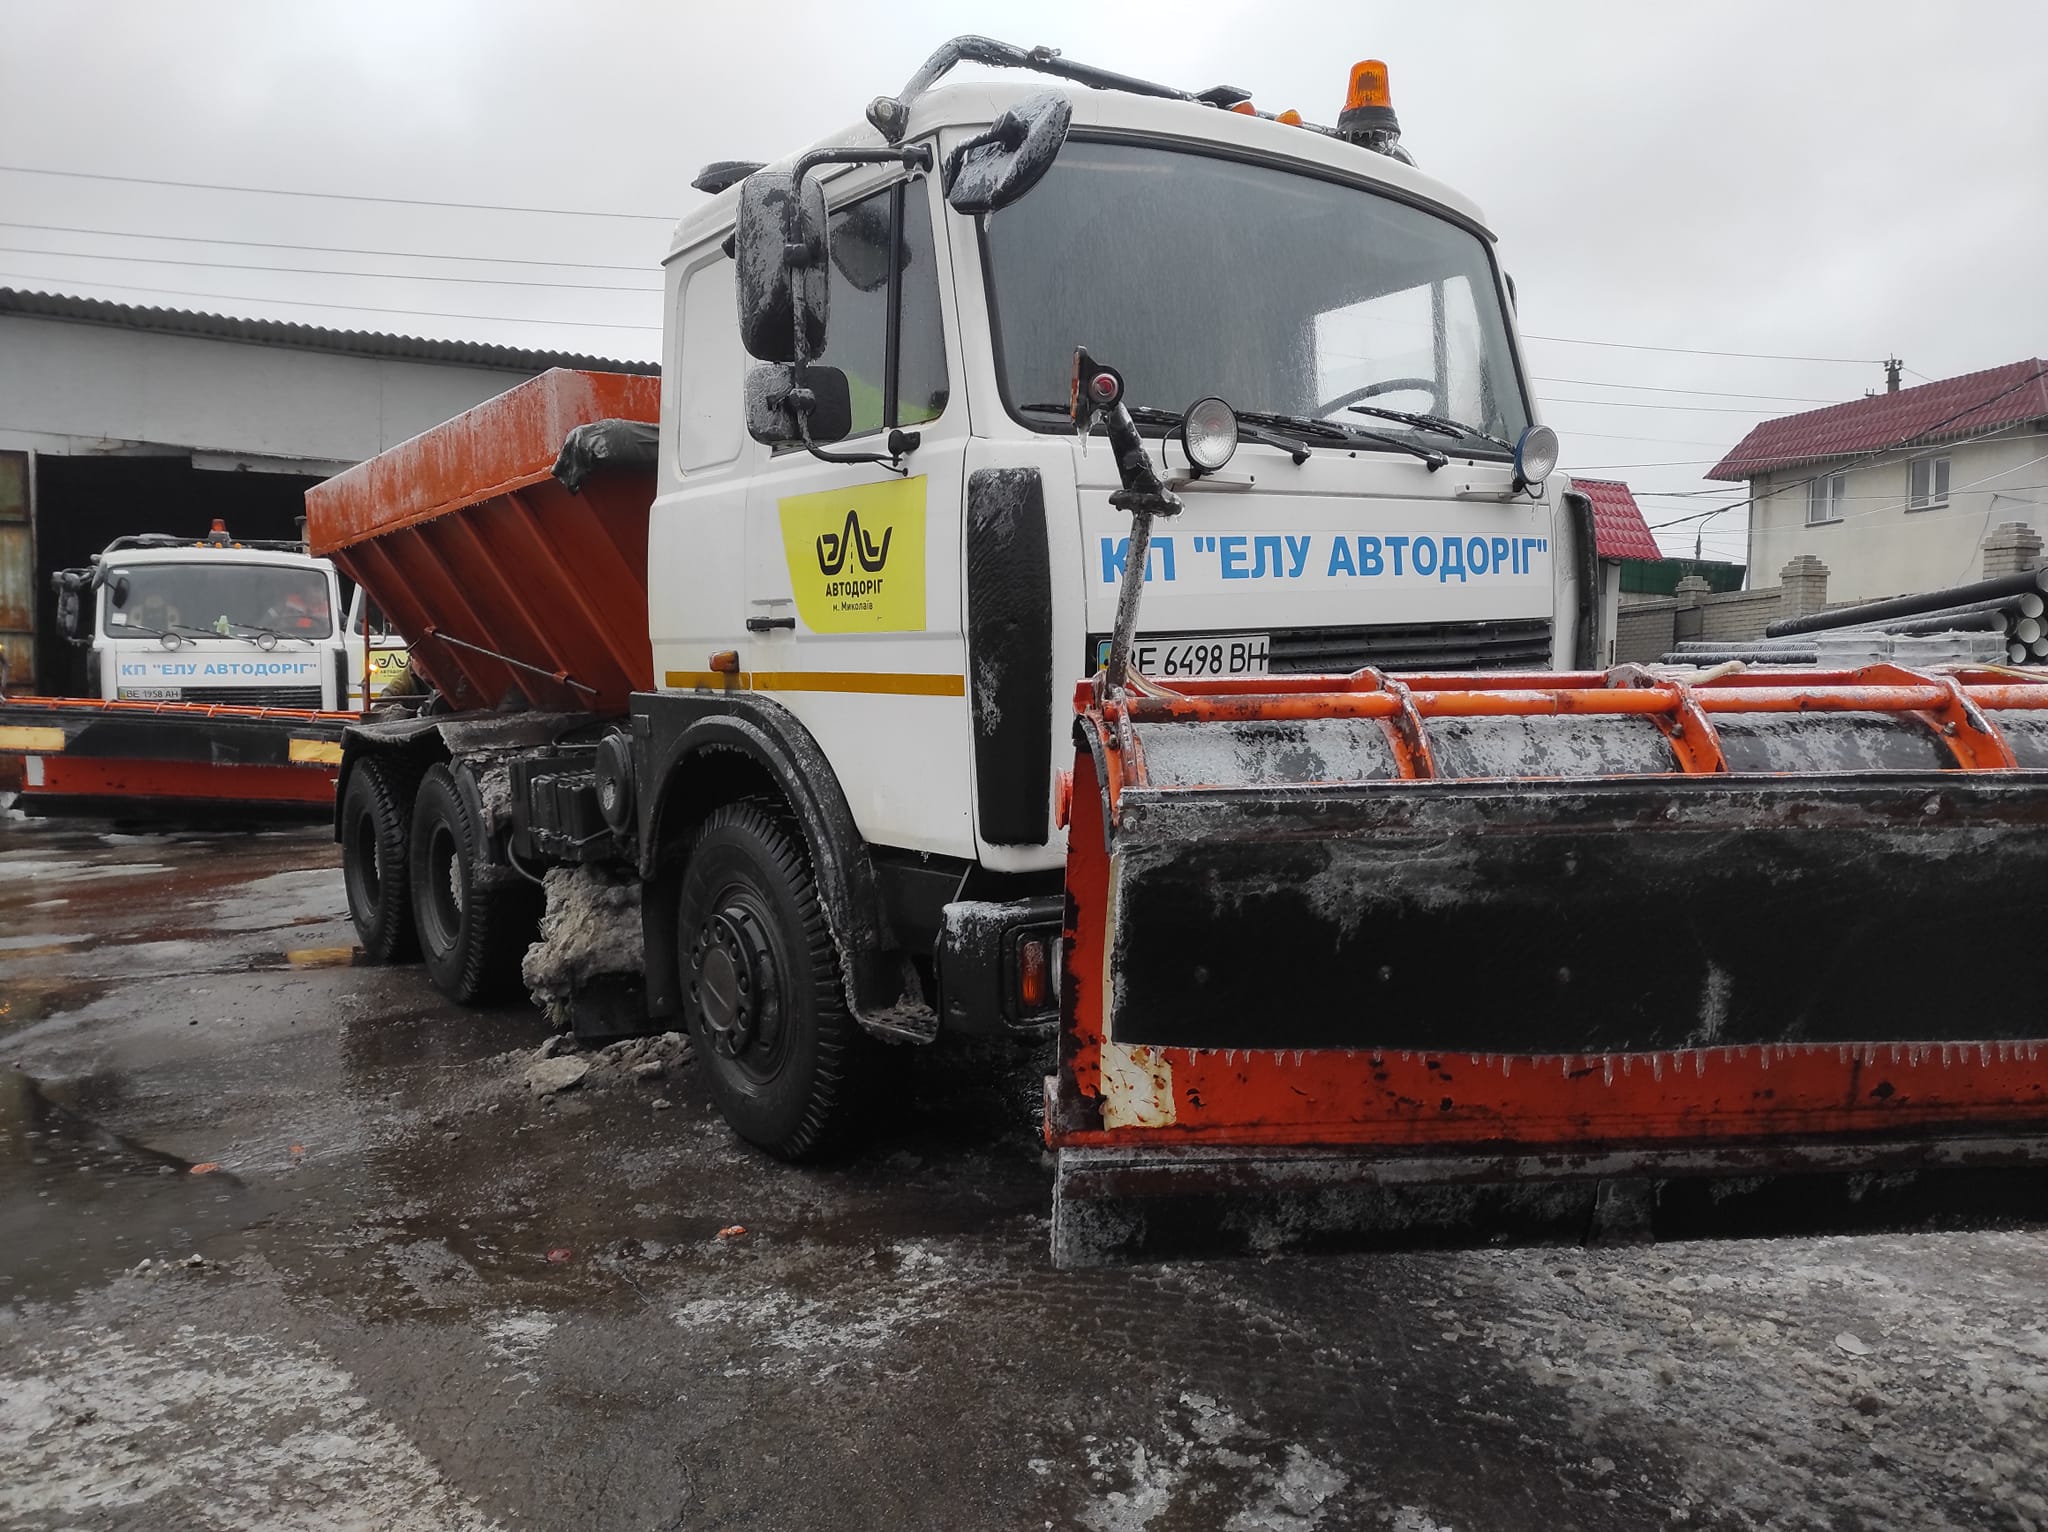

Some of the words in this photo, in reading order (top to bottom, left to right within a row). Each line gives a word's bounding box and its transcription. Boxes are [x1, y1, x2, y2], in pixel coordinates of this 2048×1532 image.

[1100, 537, 1176, 583] КП
[1193, 536, 1312, 580] "ЕЛУ
[1327, 536, 1548, 583] АВТОДОРІГ"
[826, 579, 883, 597] АВТОДОРІГ
[841, 600, 873, 611] Миколаїв
[1164, 645, 1222, 675] 6498
[121, 664, 146, 675] КП
[152, 664, 198, 675] "ЕЛУ
[204, 663, 317, 676] АВТОДОРІГ"
[126, 689, 140, 698] ВЕ
[142, 689, 163, 698] 1958
